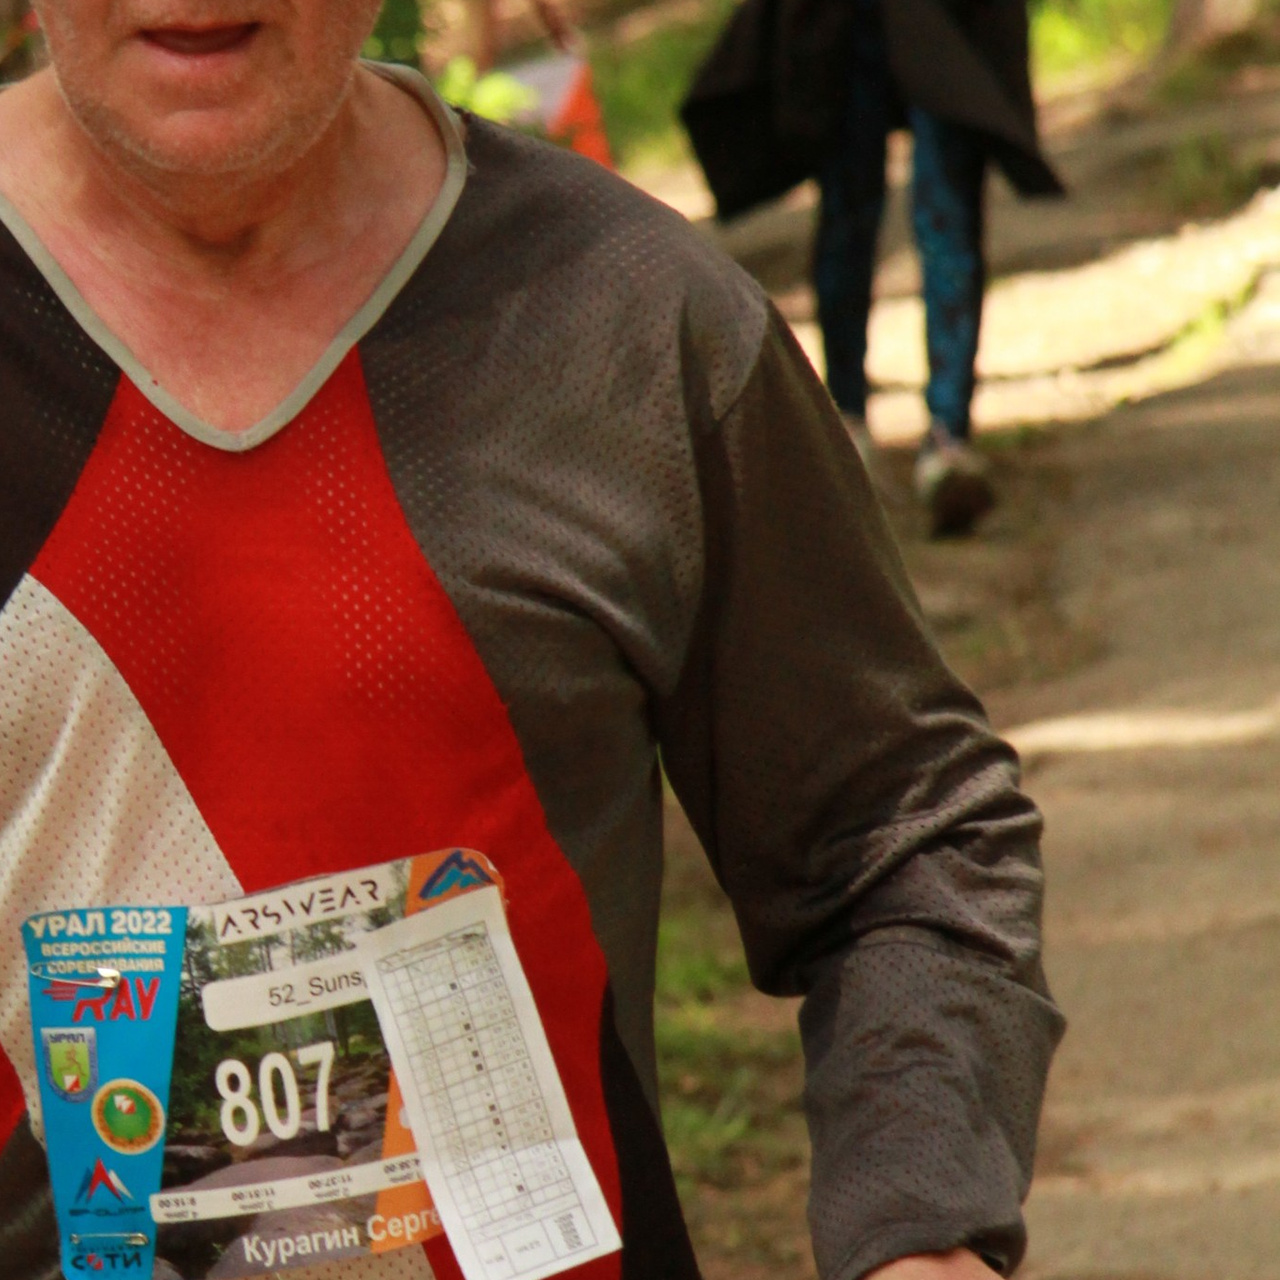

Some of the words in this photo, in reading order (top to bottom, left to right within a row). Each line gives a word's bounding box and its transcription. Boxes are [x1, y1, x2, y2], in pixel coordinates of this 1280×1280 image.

[27, 910, 106, 939] УРАЛ
[110, 909, 173, 935] 2022
[220, 878, 380, 938] ARSWEAR
[40, 937, 167, 957] ВСЕРОССИЙСКИЕ
[214, 1040, 336, 1148] 807
[241, 1226, 360, 1268] Курагин
